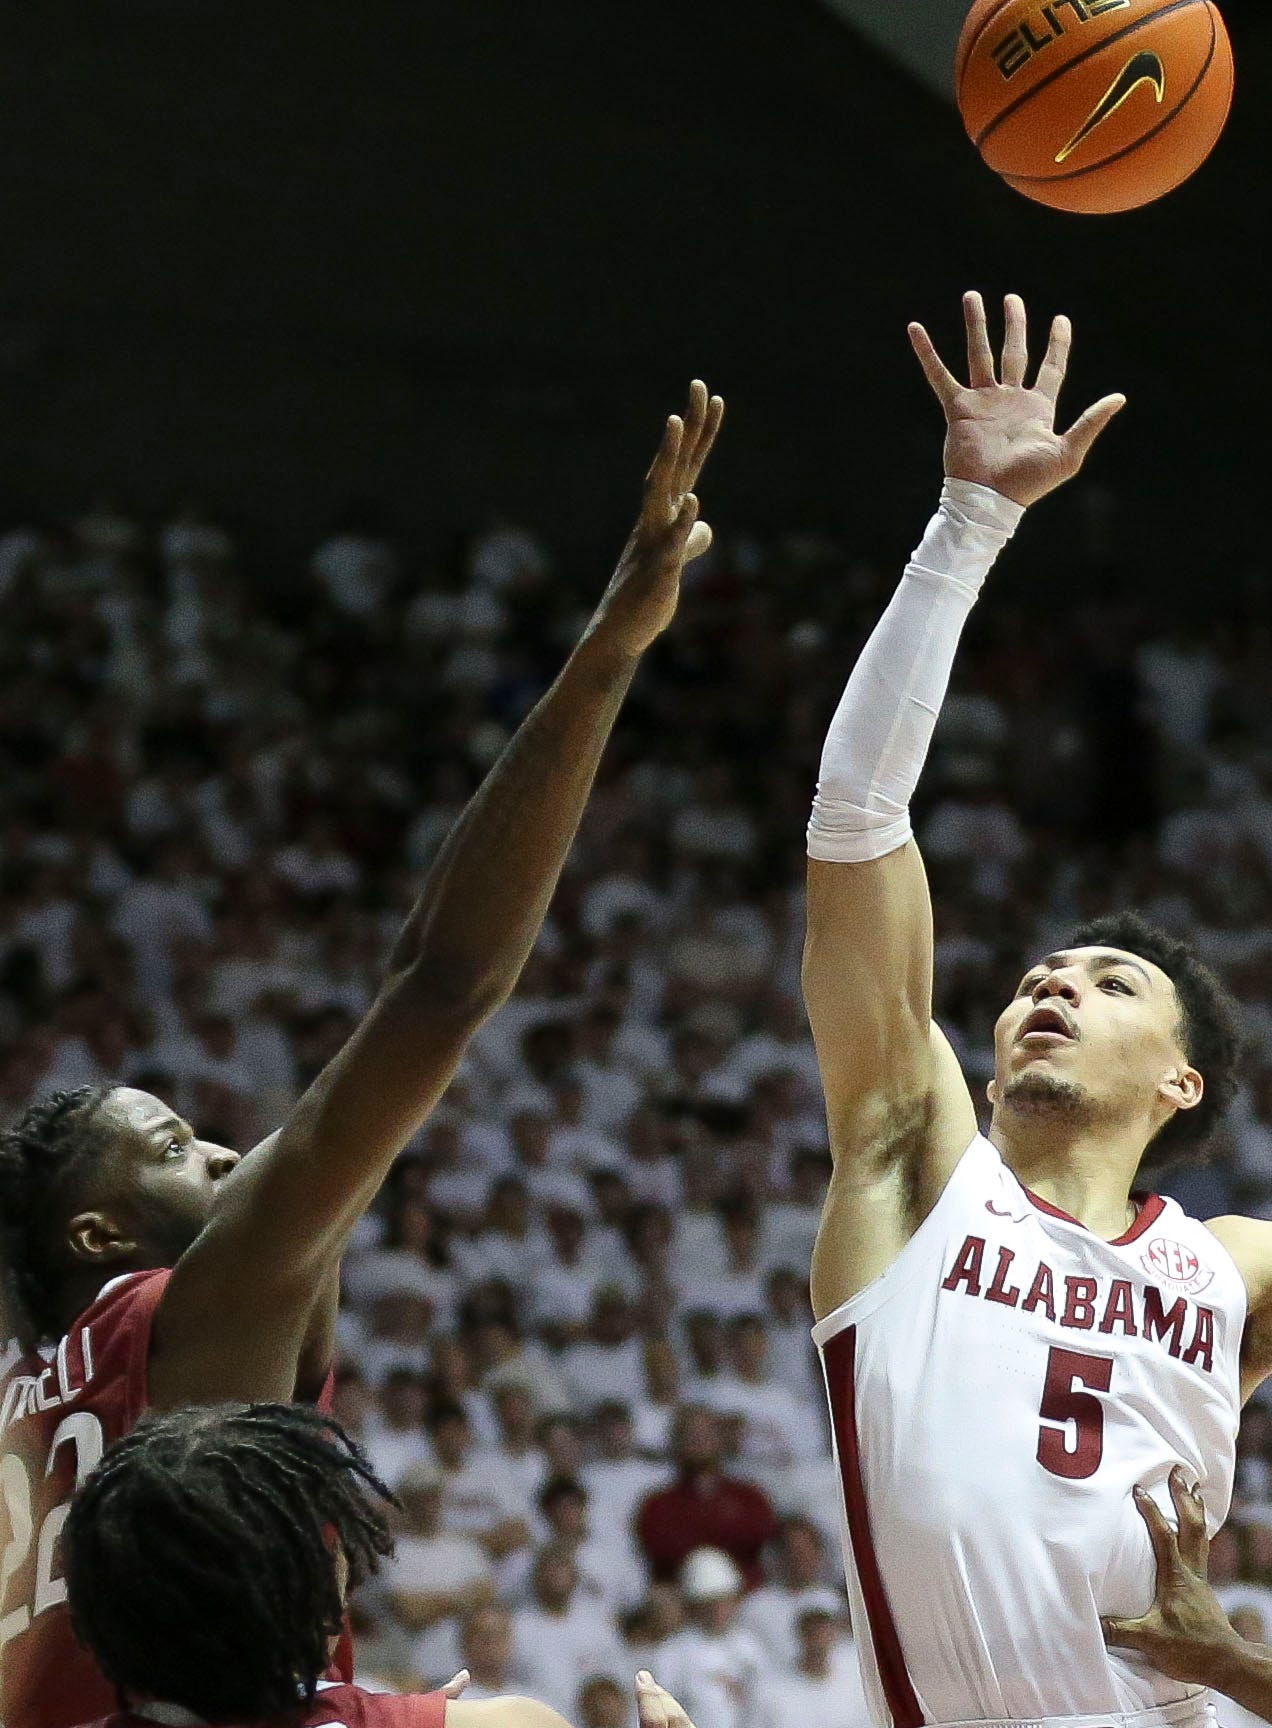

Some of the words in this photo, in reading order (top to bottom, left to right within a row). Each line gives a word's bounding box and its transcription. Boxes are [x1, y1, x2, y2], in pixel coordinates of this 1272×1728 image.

[942, 1235, 1213, 1373] ALABAMA
[1149, 1239, 1198, 1280] SEC
[1036, 1345, 1114, 1479] 5
